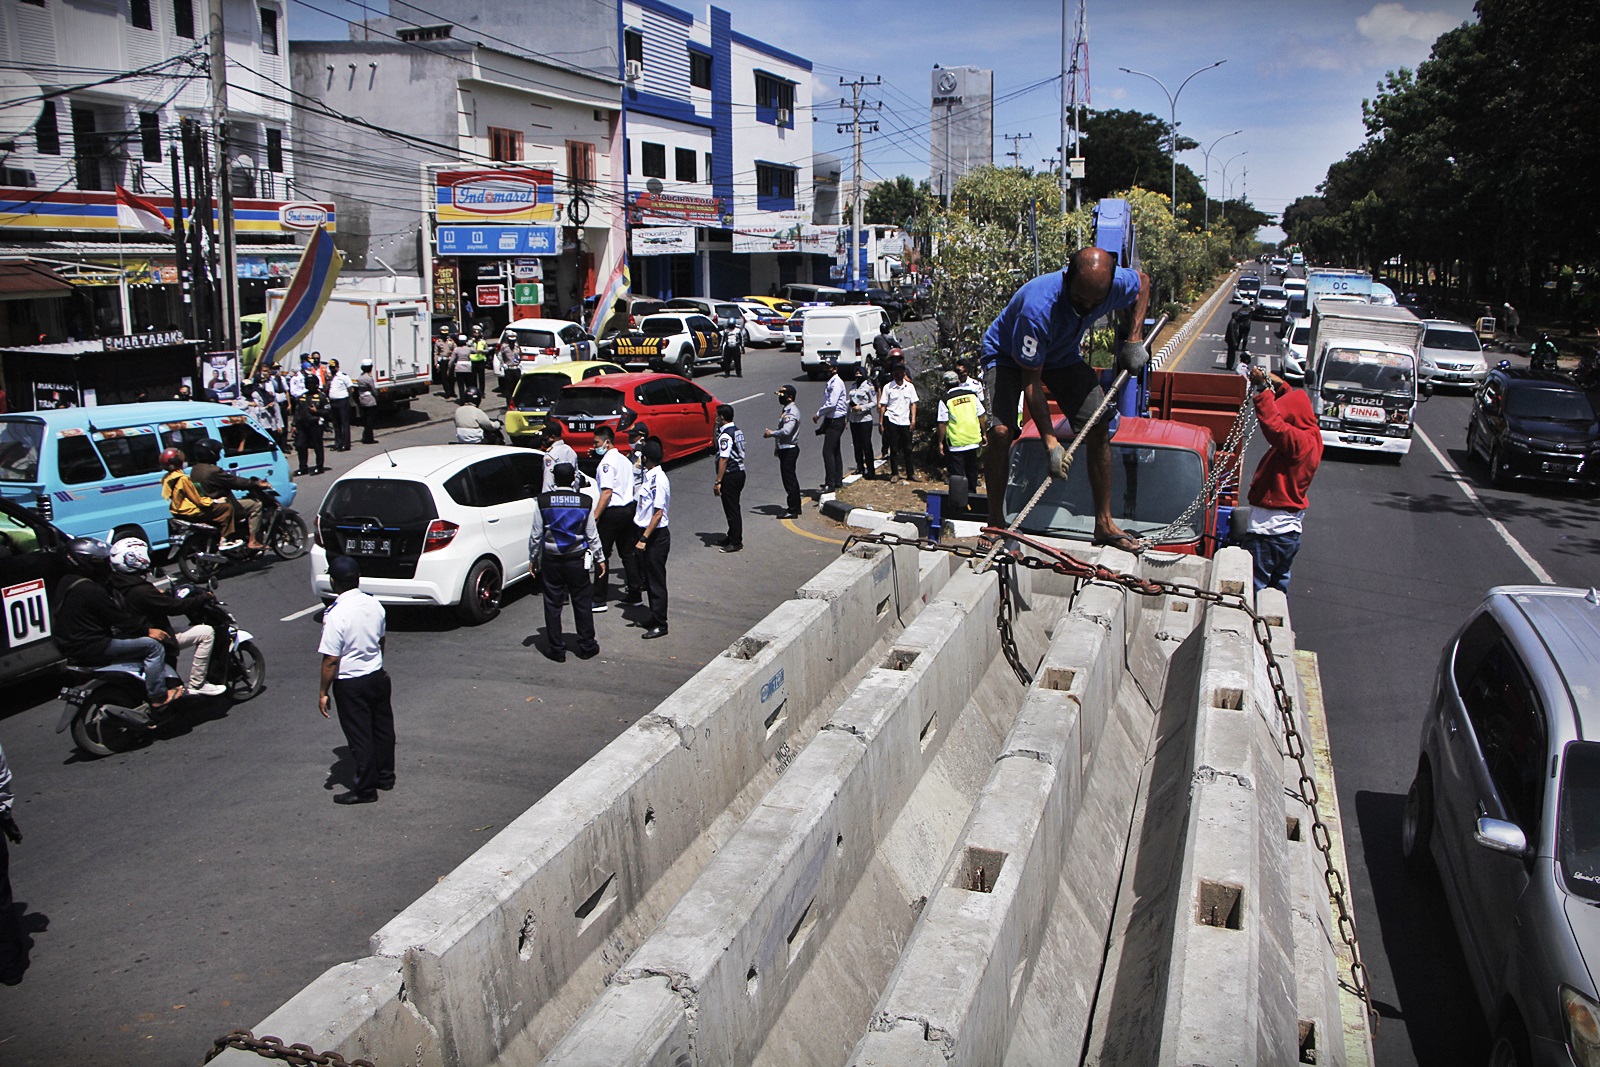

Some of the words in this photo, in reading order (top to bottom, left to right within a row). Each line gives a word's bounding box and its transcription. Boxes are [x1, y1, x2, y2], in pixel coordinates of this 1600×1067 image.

[458, 187, 533, 203] Indomaret
[287, 211, 324, 221] Indomaret
[113, 331, 177, 348] MARTABAK
[1022, 335, 1038, 357] 9
[618, 346, 658, 355] DISHUB
[1350, 397, 1384, 406] ISUZU
[1350, 407, 1379, 416] FINNA
[10, 594, 47, 640] 04
